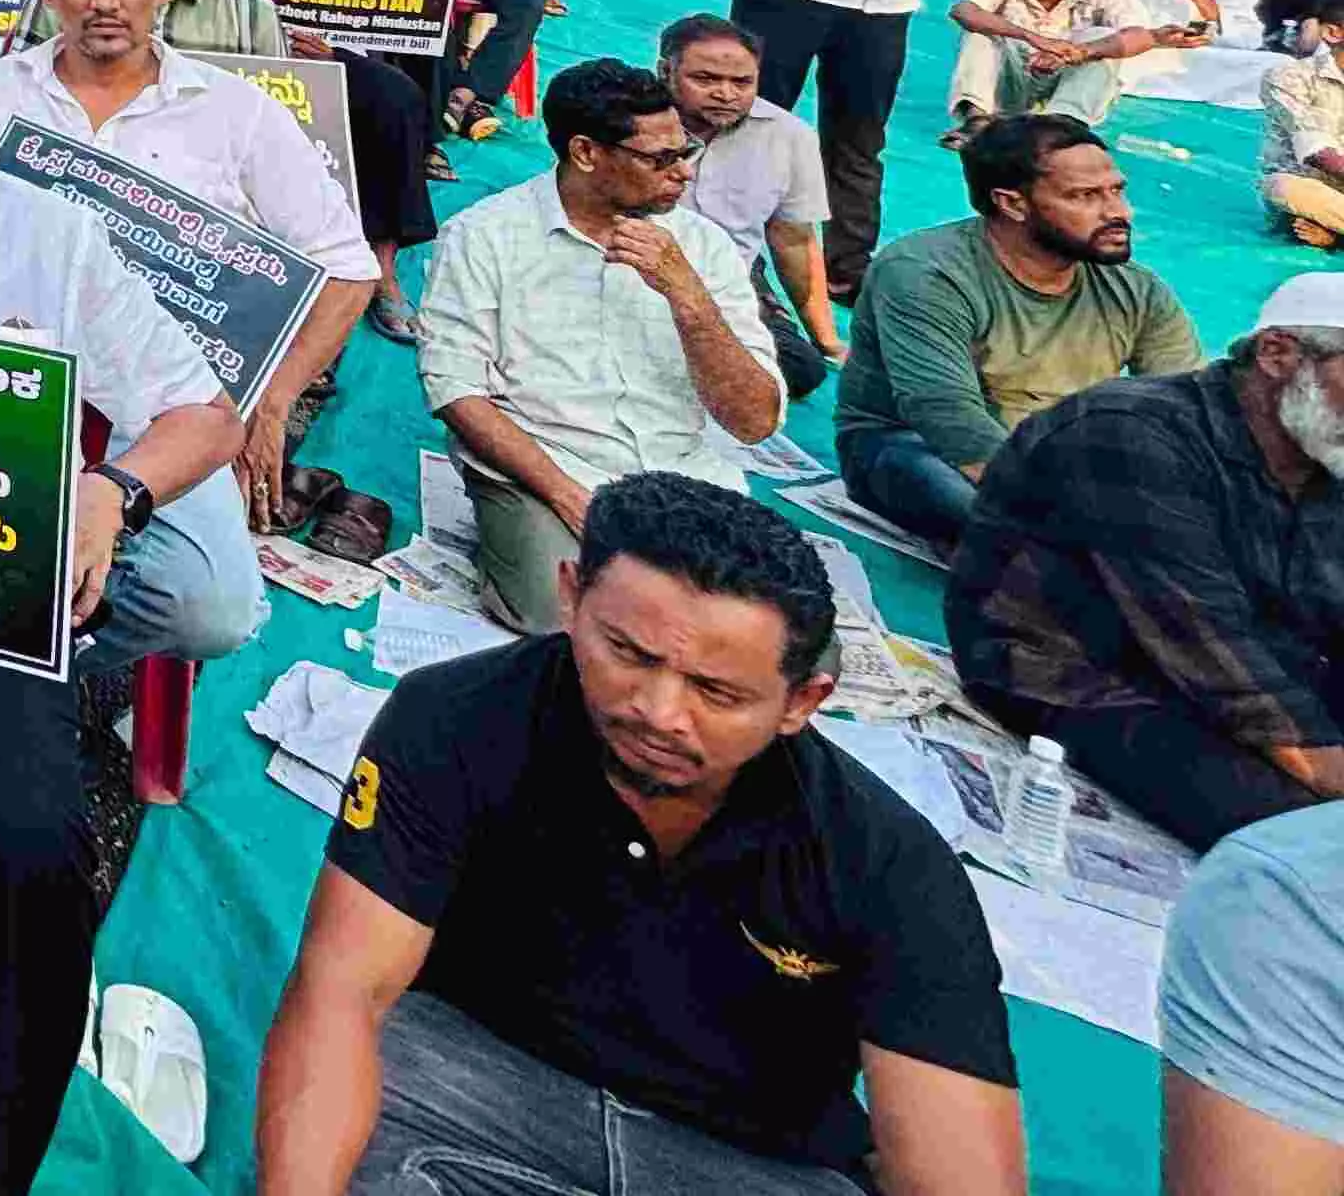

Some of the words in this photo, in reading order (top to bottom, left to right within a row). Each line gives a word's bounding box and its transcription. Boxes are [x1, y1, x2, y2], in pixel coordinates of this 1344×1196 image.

[371, 15, 441, 33] Hindustan
[16, 136, 72, 177] ಕ್ರೈಸ್ತ
[68, 156, 205, 244] ಮಂಡಳಿಯಲ್ಲಿ
[343, 755, 379, 831] 3
